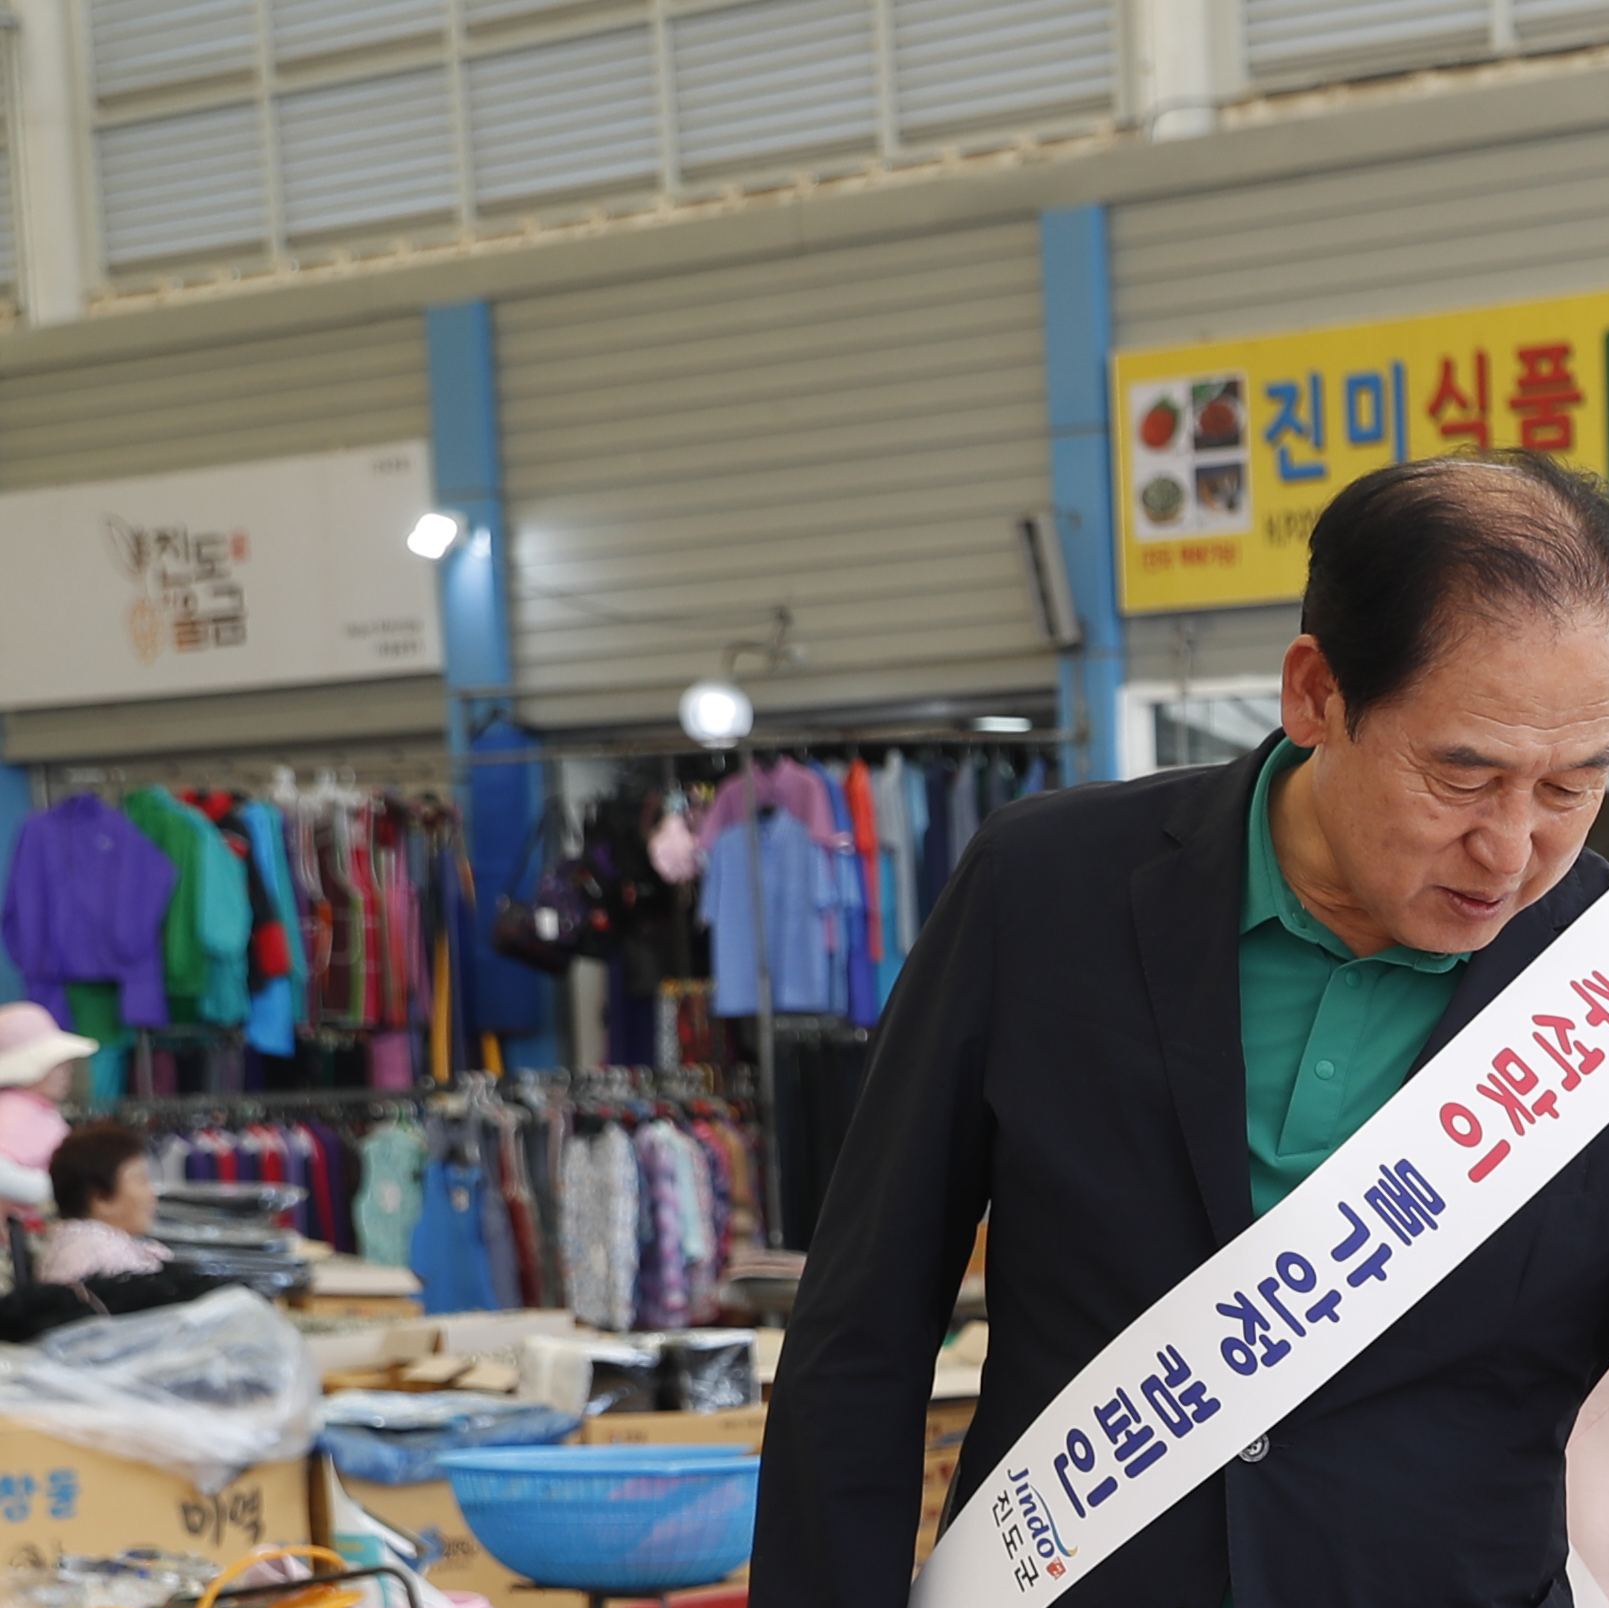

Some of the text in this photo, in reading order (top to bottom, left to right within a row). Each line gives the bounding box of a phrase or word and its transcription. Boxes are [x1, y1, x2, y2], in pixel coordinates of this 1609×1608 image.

[1264, 344, 1583, 483] 진미식품
[1215, 1158, 1446, 1377] 물가안정
[1053, 1343, 1222, 1519] 캠페인
[992, 1489, 1040, 1594] 진도군
[1007, 1467, 1056, 1559] Jindo
